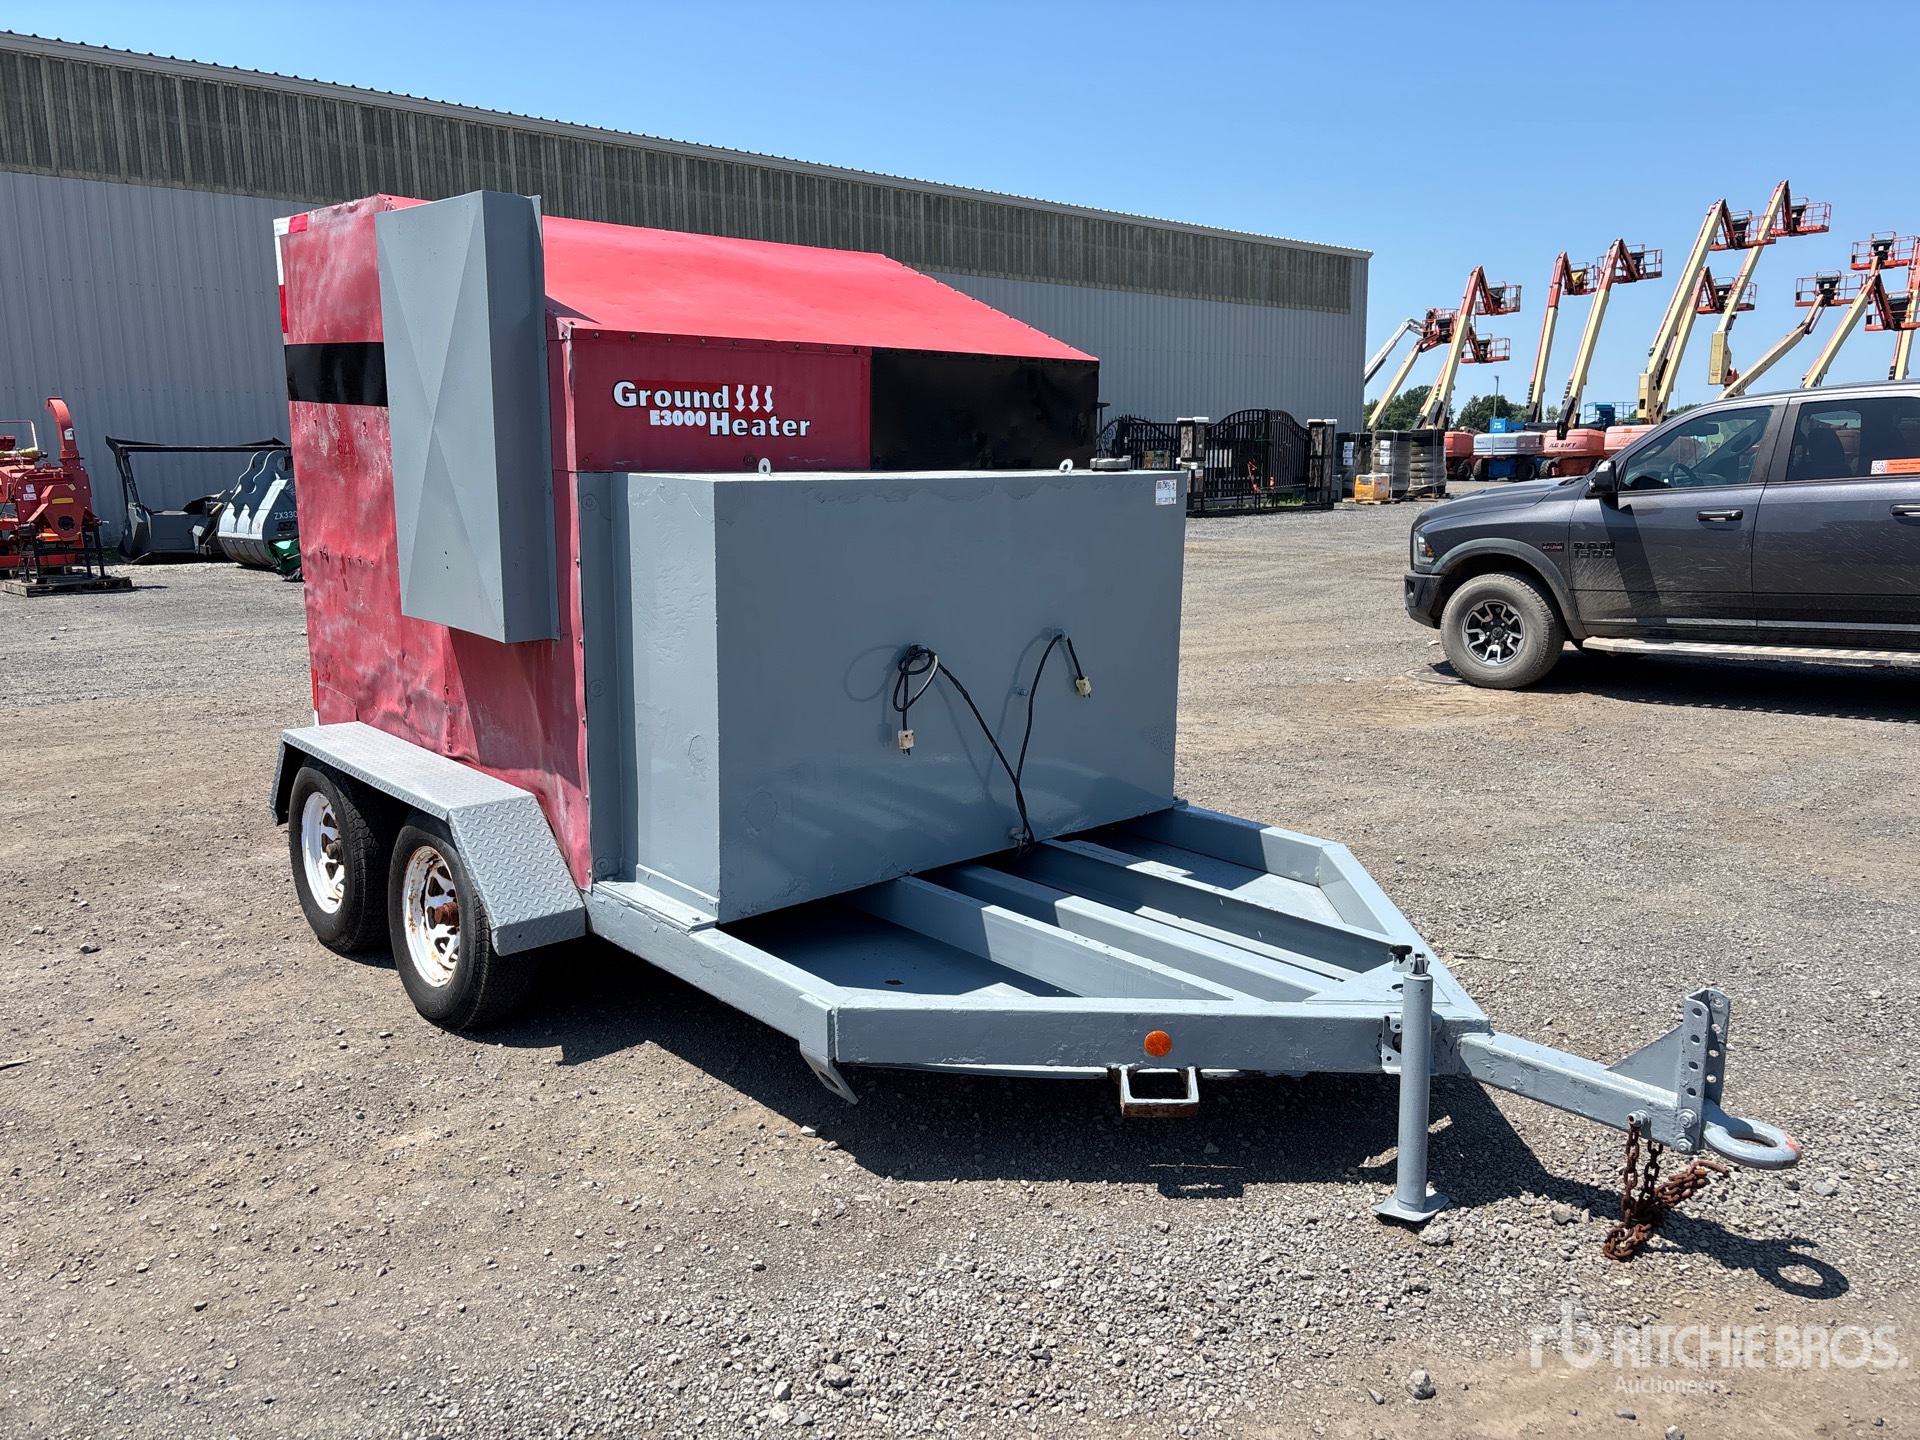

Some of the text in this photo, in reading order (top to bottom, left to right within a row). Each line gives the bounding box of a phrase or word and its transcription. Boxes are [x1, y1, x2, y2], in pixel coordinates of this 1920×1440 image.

[613, 380, 730, 409] Ground
[649, 409, 707, 427] E3000
[708, 411, 811, 437] Heater
[1573, 541, 1615, 549] RAM
[1574, 549, 1615, 558] 1500
